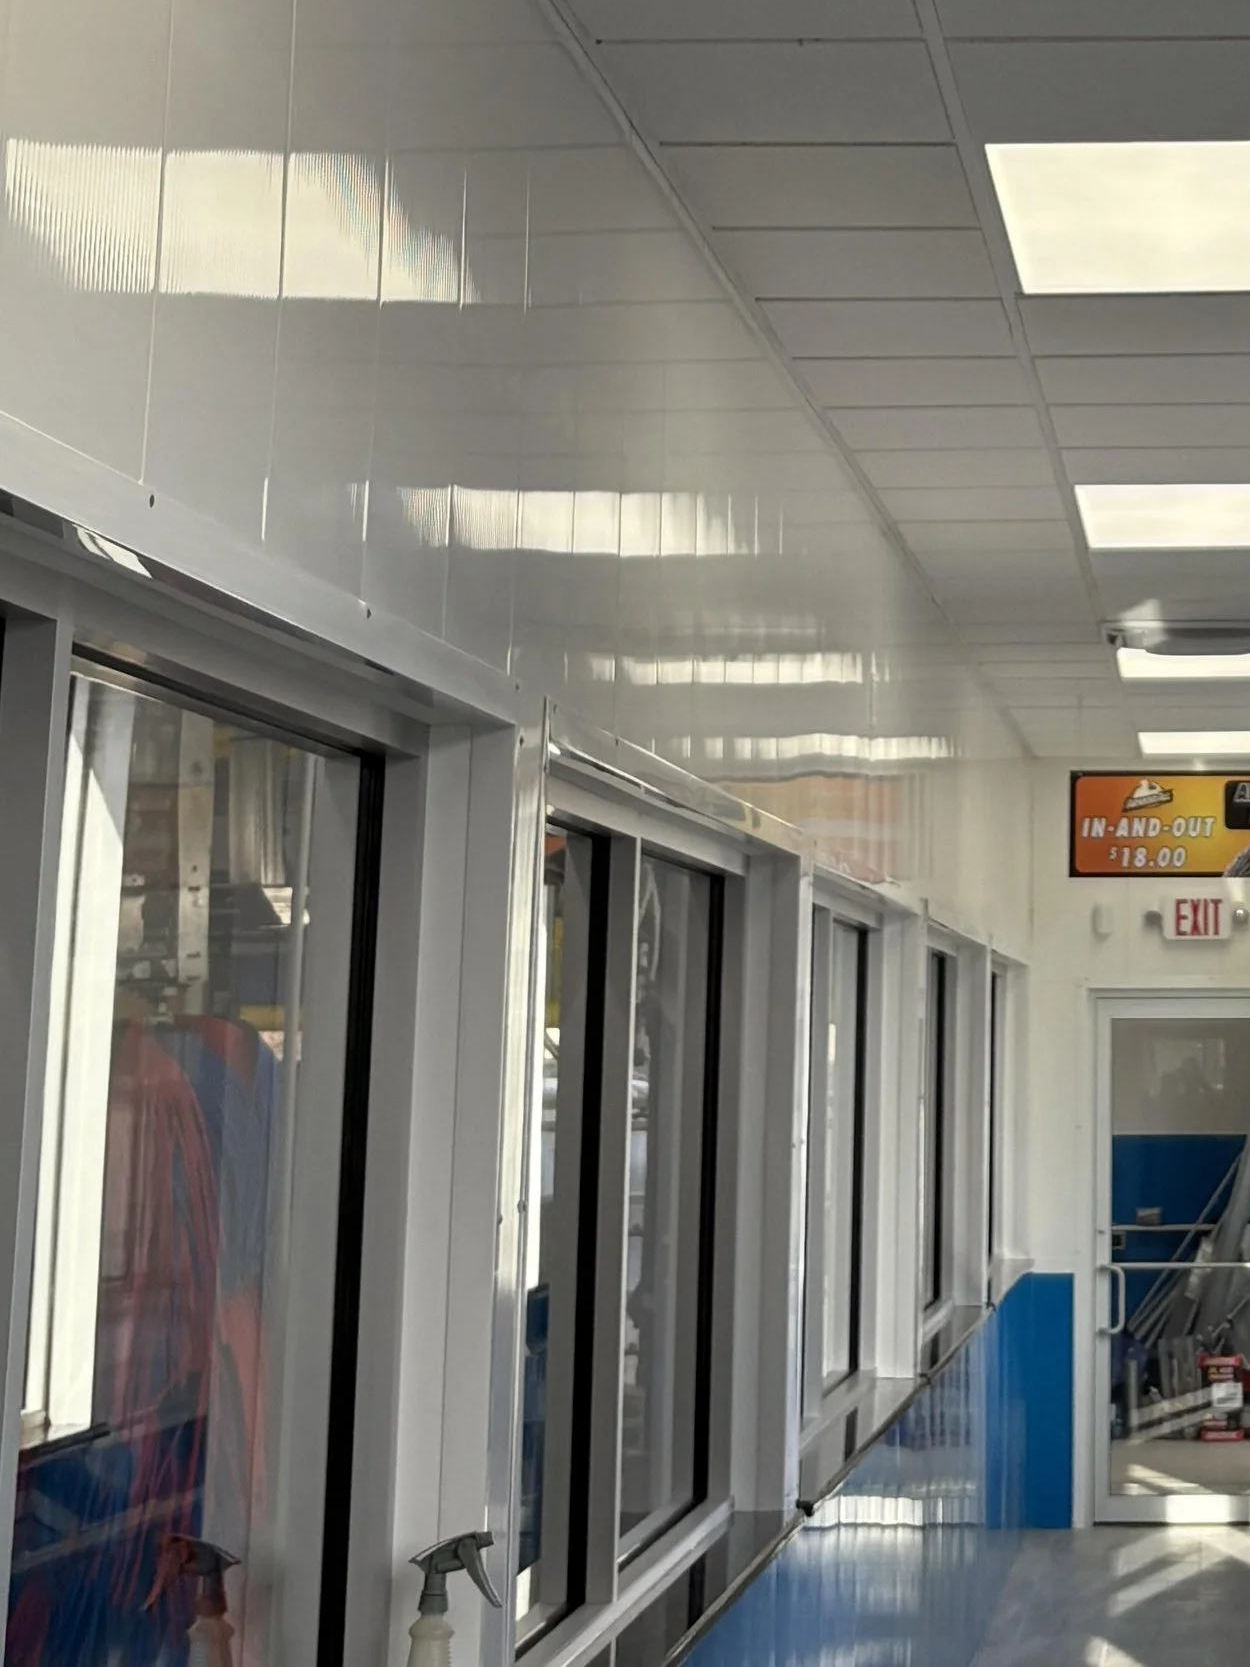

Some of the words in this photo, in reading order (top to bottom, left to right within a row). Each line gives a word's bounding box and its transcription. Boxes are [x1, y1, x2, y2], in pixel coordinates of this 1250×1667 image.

[1081, 817, 1216, 838] IN-AND-OUT
[1109, 846, 1187, 869] $18.00
[1175, 898, 1223, 936] EXIT
